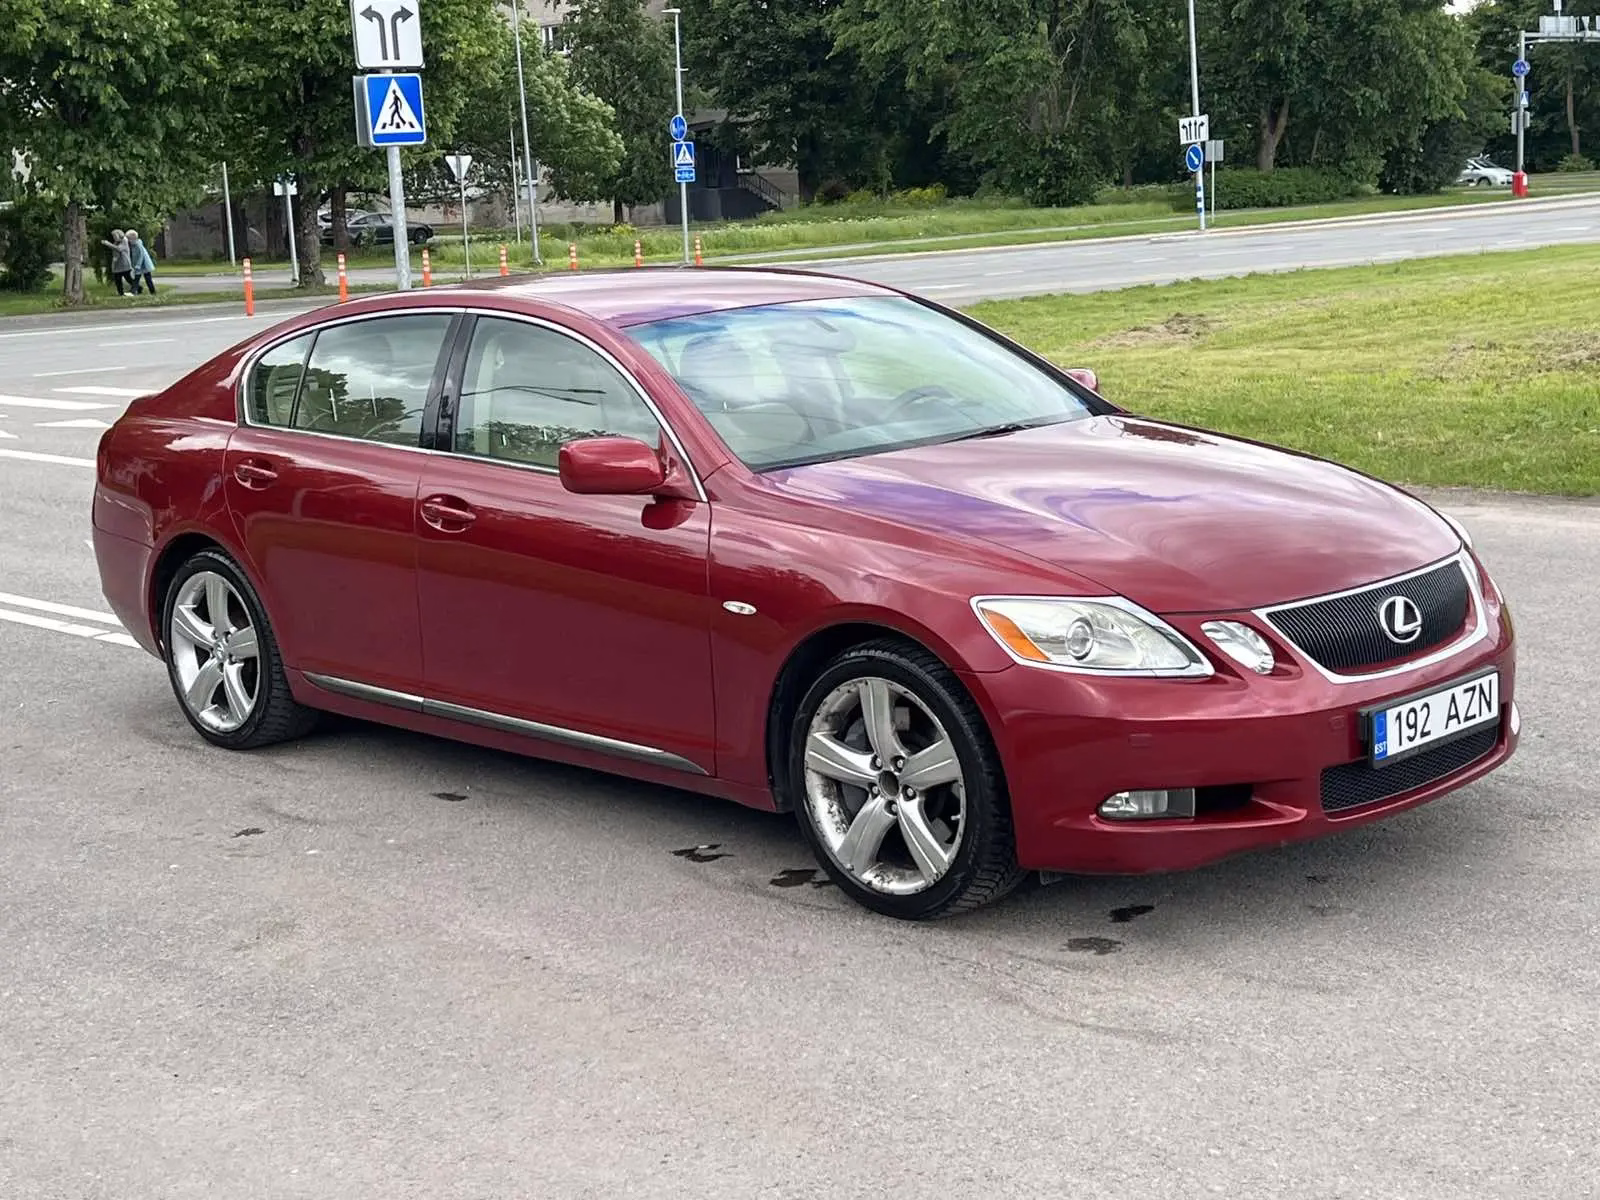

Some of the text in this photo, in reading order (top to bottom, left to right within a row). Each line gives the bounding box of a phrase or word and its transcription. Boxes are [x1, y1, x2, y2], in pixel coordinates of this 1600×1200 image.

[1395, 679, 1493, 747] 192 AZN
[1374, 741, 1388, 754] EST
